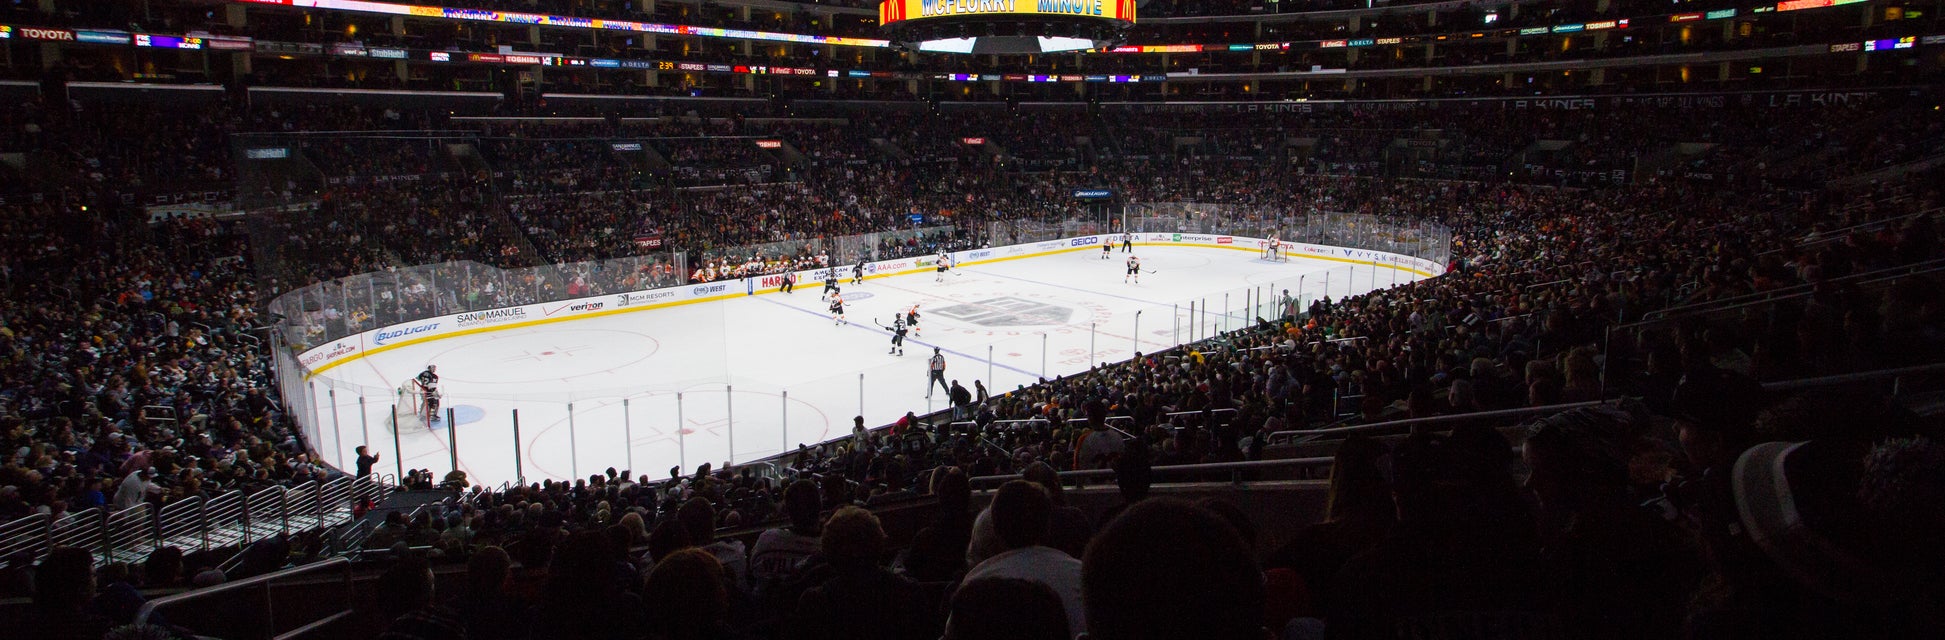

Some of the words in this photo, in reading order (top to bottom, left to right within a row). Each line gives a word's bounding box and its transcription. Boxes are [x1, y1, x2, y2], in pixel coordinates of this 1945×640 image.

[1037, 0, 1103, 15] MINUTE
[1585, 21, 1616, 30] TOSHIBA
[20, 28, 74, 41] TOYOTA
[343, 49, 368, 57] verion
[506, 56, 541, 64] TOSHIBA
[659, 61, 674, 70] 2:39
[681, 63, 704, 71] STAPLES
[1264, 103, 1313, 113] KINGS
[1071, 236, 1098, 247] GEICO
[877, 262, 907, 271] AAA.com
[814, 267, 848, 276] AMECAN
[709, 285, 726, 293] WEST
[646, 291, 675, 300] RESORTS
[570, 302, 604, 311] verizon
[457, 313, 478, 323] SAN
[486, 307, 526, 319] MANUEL
[377, 330, 401, 341] BUD
[404, 323, 441, 336] LIGHT
